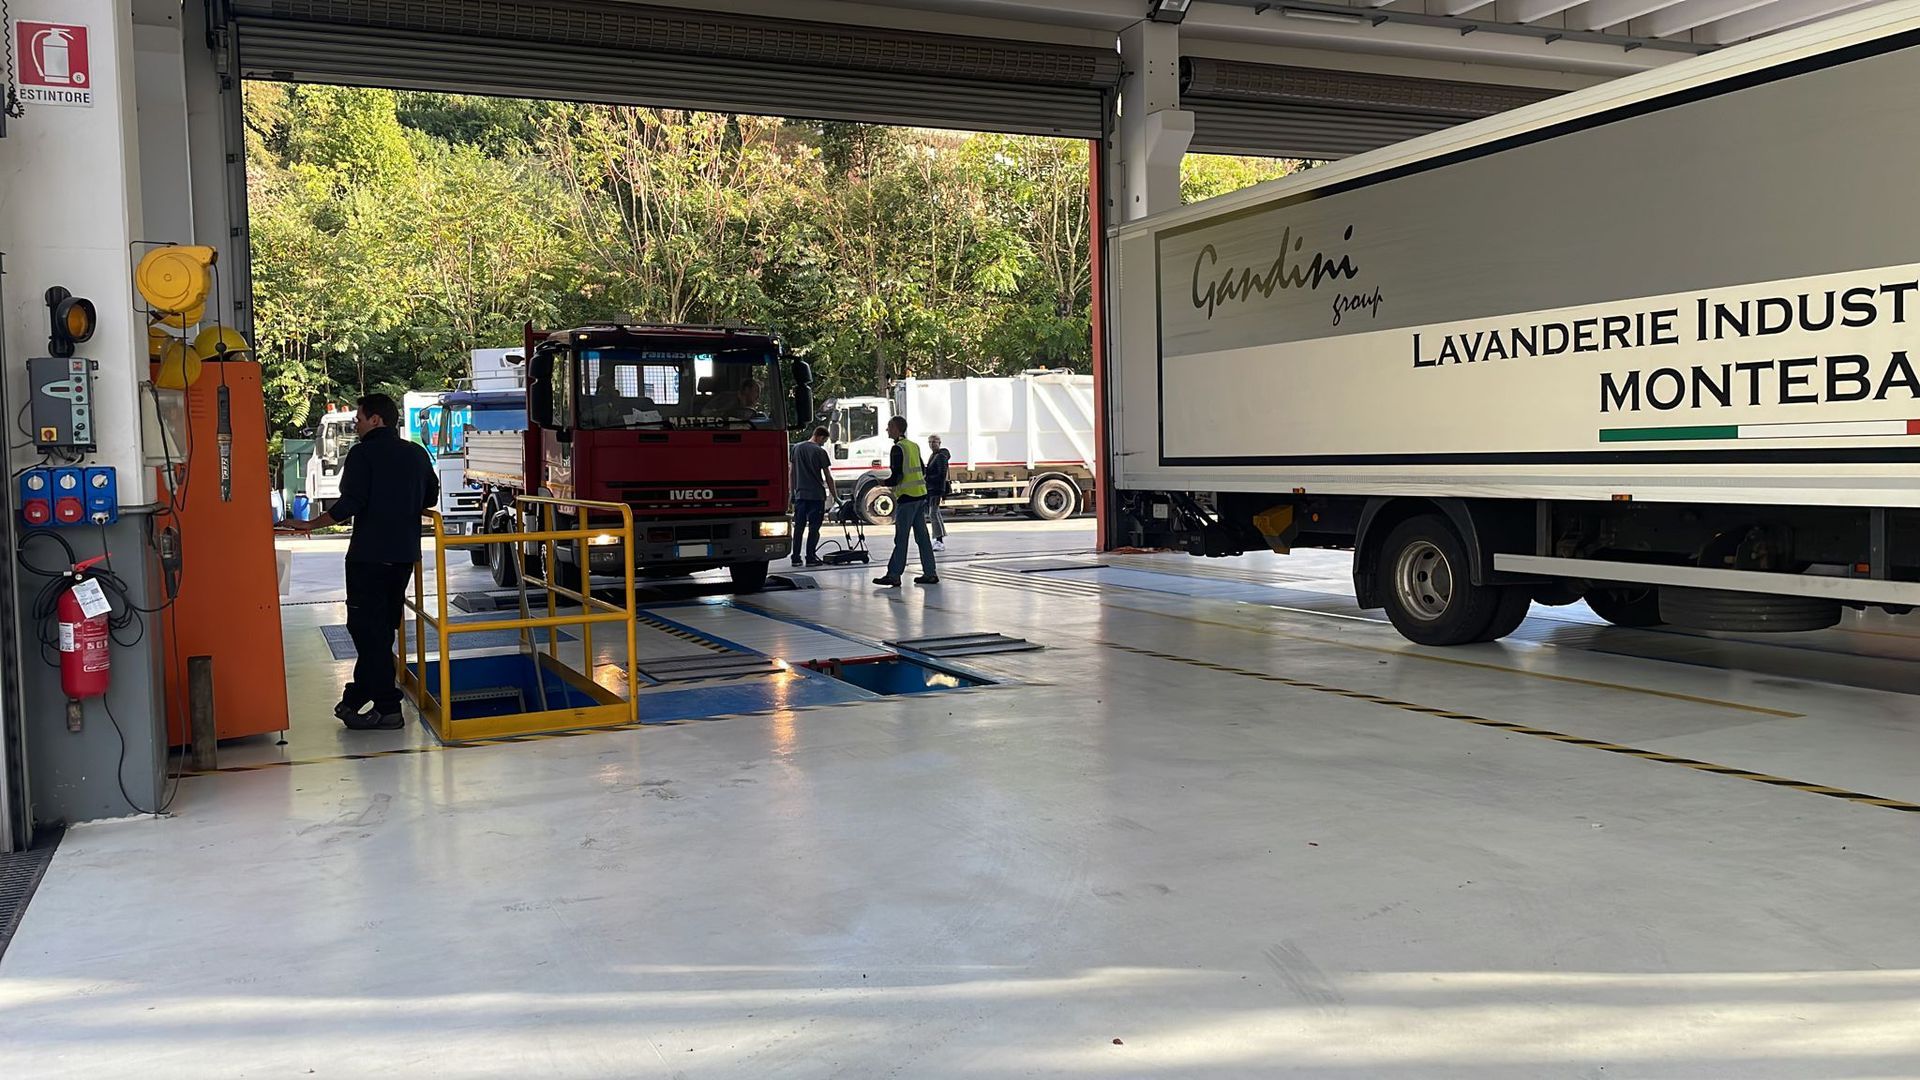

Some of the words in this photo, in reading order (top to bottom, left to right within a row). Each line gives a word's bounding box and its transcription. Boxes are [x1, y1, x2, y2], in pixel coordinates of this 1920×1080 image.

[20, 88, 91, 104] ESTINTORE
[1192, 224, 1360, 320] Gandini
[1332, 285, 1384, 327] group
[669, 489, 714, 500] IVECO
